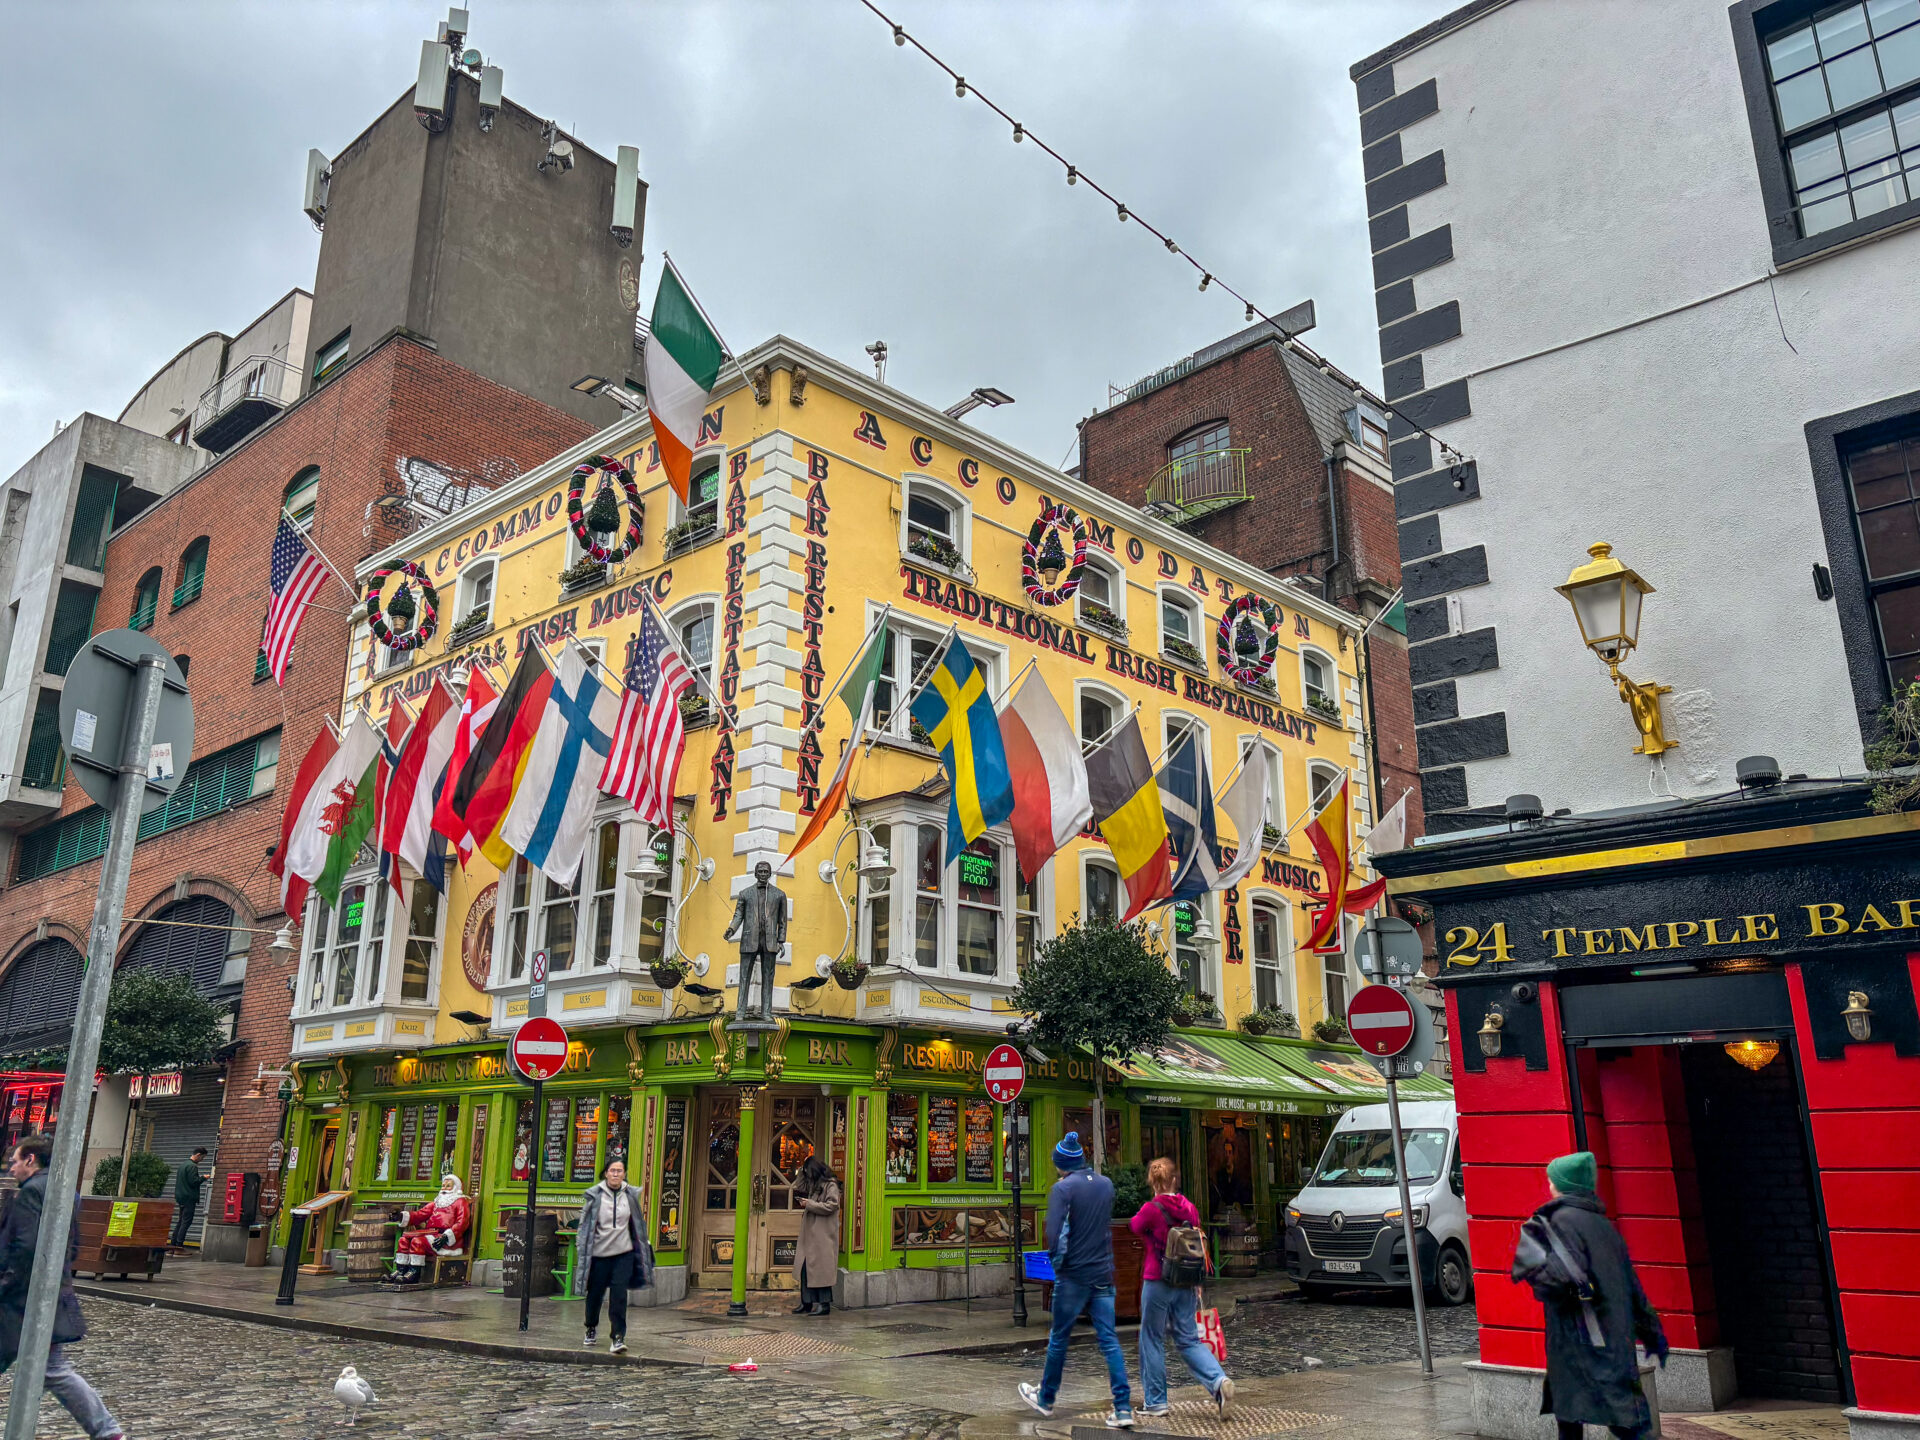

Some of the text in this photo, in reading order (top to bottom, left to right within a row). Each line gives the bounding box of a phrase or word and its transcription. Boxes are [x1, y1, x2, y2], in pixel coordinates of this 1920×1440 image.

[588, 568, 673, 629] MUSIC
[711, 451, 748, 822] BAR RESTAURANT
[797, 450, 830, 817] BAR RESTAURANT
[900, 565, 1317, 746] TRADITIONAL IRISH RESTAURANT
[963, 873, 989, 887] FOOD
[964, 862, 987, 876] IRISH
[1262, 857, 1321, 893] MUSIC
[1224, 884, 1243, 964] BAR
[1446, 922, 1516, 967] 24
[1542, 913, 1779, 958] TEMPLE
[637, 991, 655, 1003] bar
[870, 992, 885, 1003] bar
[665, 1039, 702, 1066] BAR
[808, 1039, 852, 1065] BAR
[317, 1070, 332, 1092] 57
[373, 1065, 397, 1087] THE
[401, 1061, 448, 1084] OLIVER
[1216, 1097, 1228, 1109] LIVE
[1229, 1098, 1245, 1110] MUSIC
[1260, 1100, 1274, 1111] 12.30
[855, 1112, 865, 1228] SMOKING AREA
[775, 1248, 797, 1256] GUINNE
